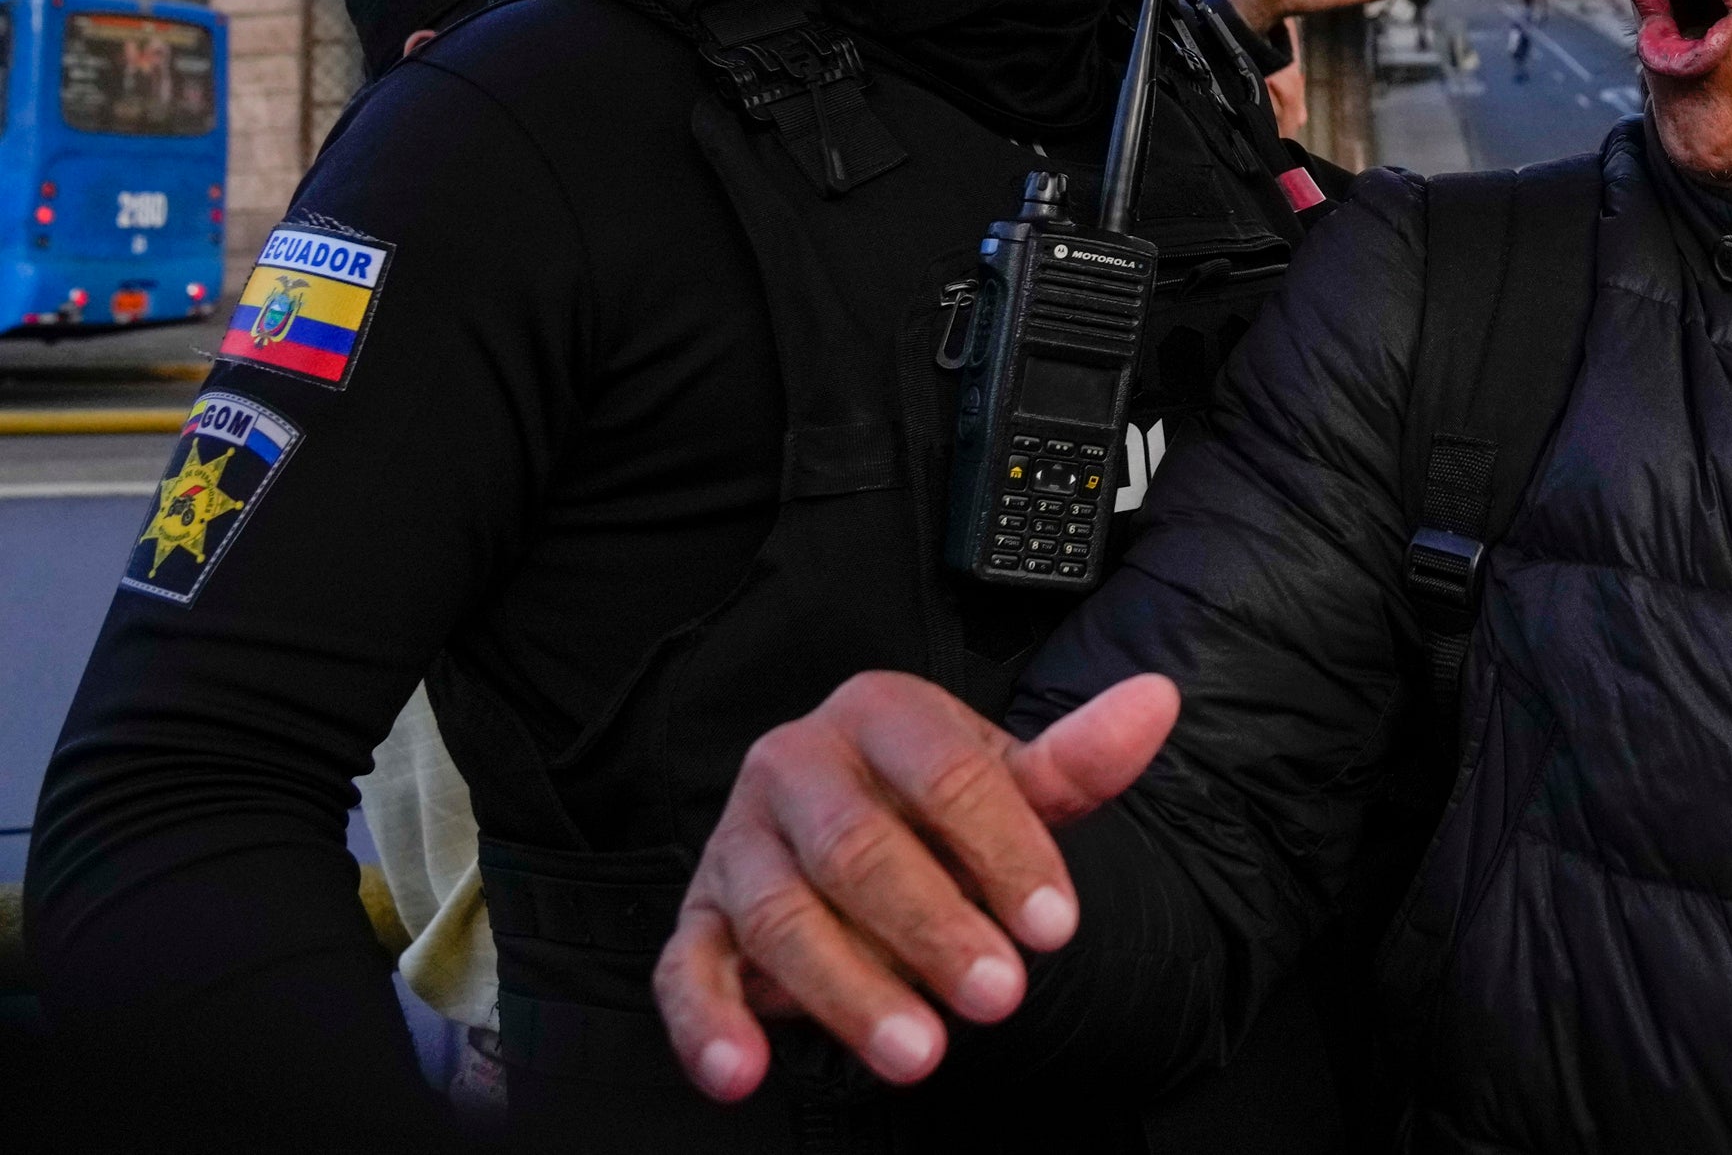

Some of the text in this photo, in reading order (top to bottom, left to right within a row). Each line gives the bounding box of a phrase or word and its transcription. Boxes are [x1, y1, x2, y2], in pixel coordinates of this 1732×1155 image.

[264, 235, 373, 280] ECUADOR
[1072, 250, 1136, 269] MOTOROLA
[201, 405, 253, 439] GOM
